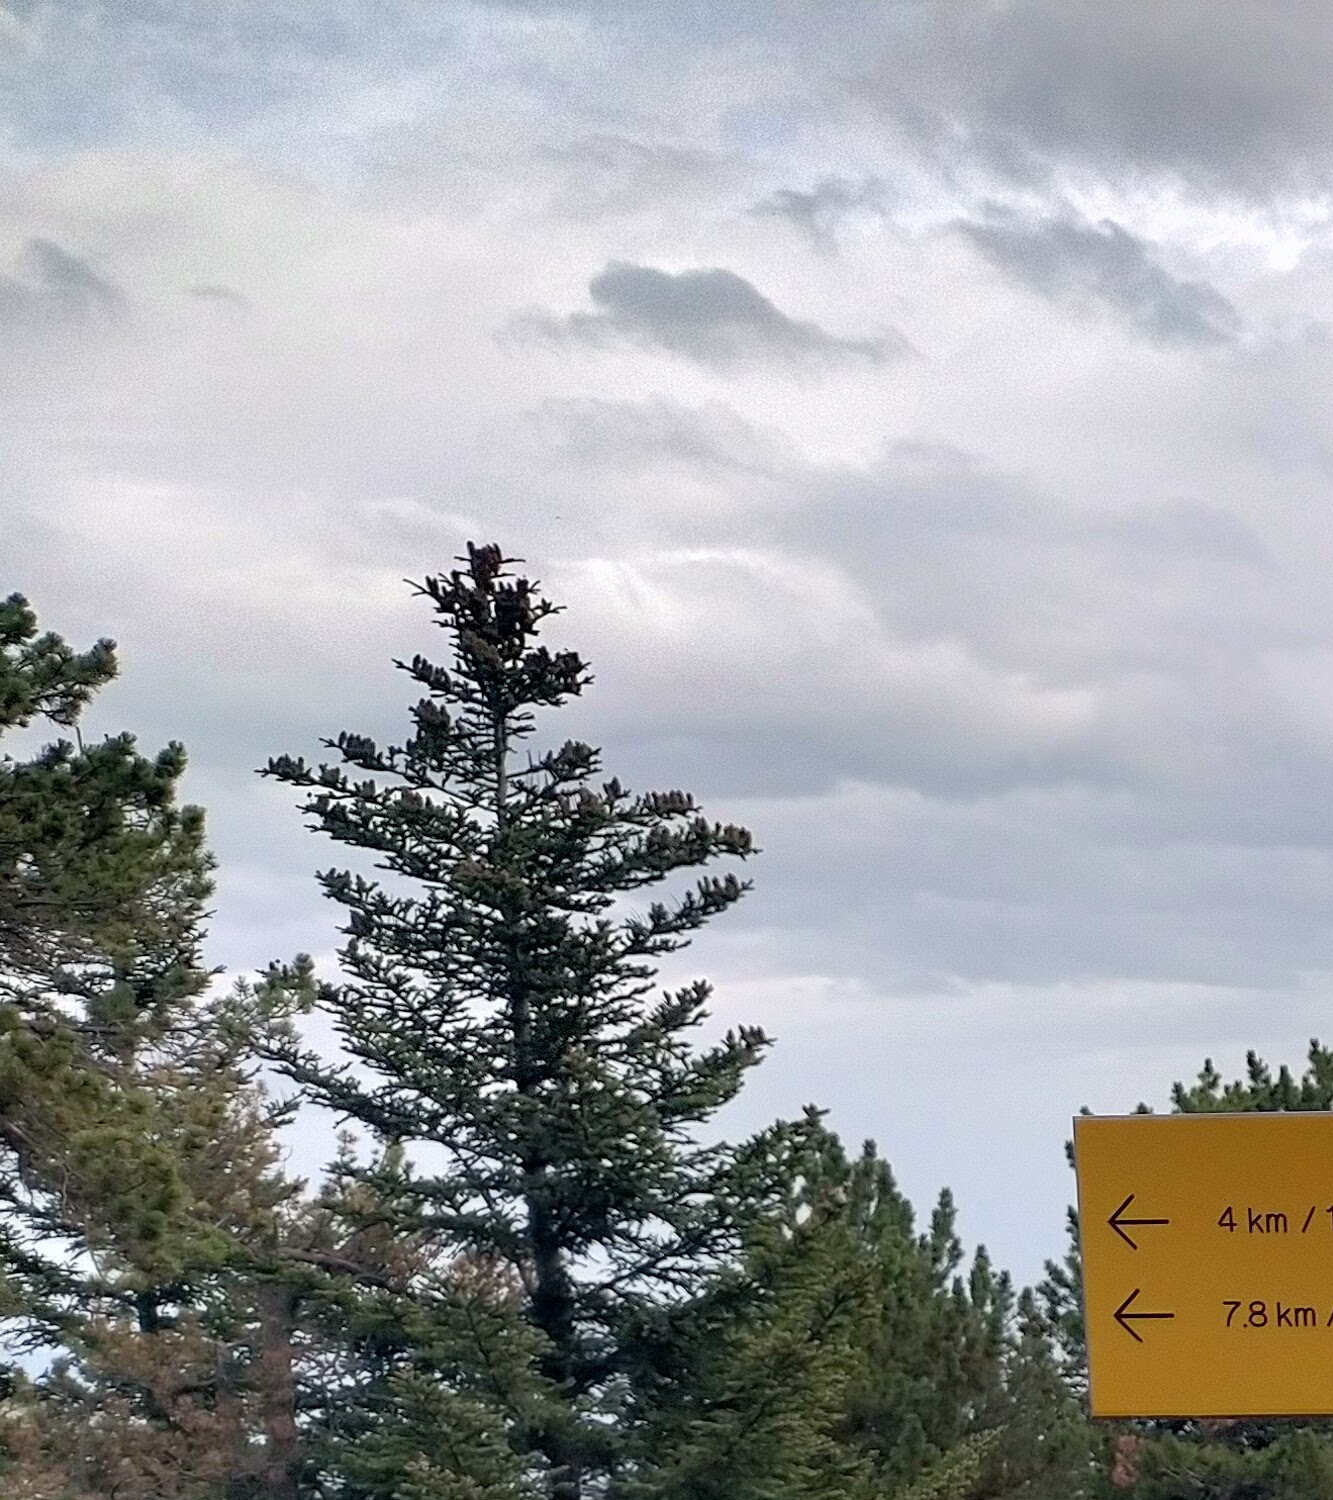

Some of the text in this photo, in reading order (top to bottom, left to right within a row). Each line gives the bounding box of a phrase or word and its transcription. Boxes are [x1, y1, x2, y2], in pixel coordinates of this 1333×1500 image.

[1217, 1206, 1238, 1233] 4
[1247, 1207, 1288, 1234] km
[1301, 1205, 1316, 1234] /
[1222, 1300, 1268, 1329] 7.8
[1276, 1301, 1317, 1328] km
